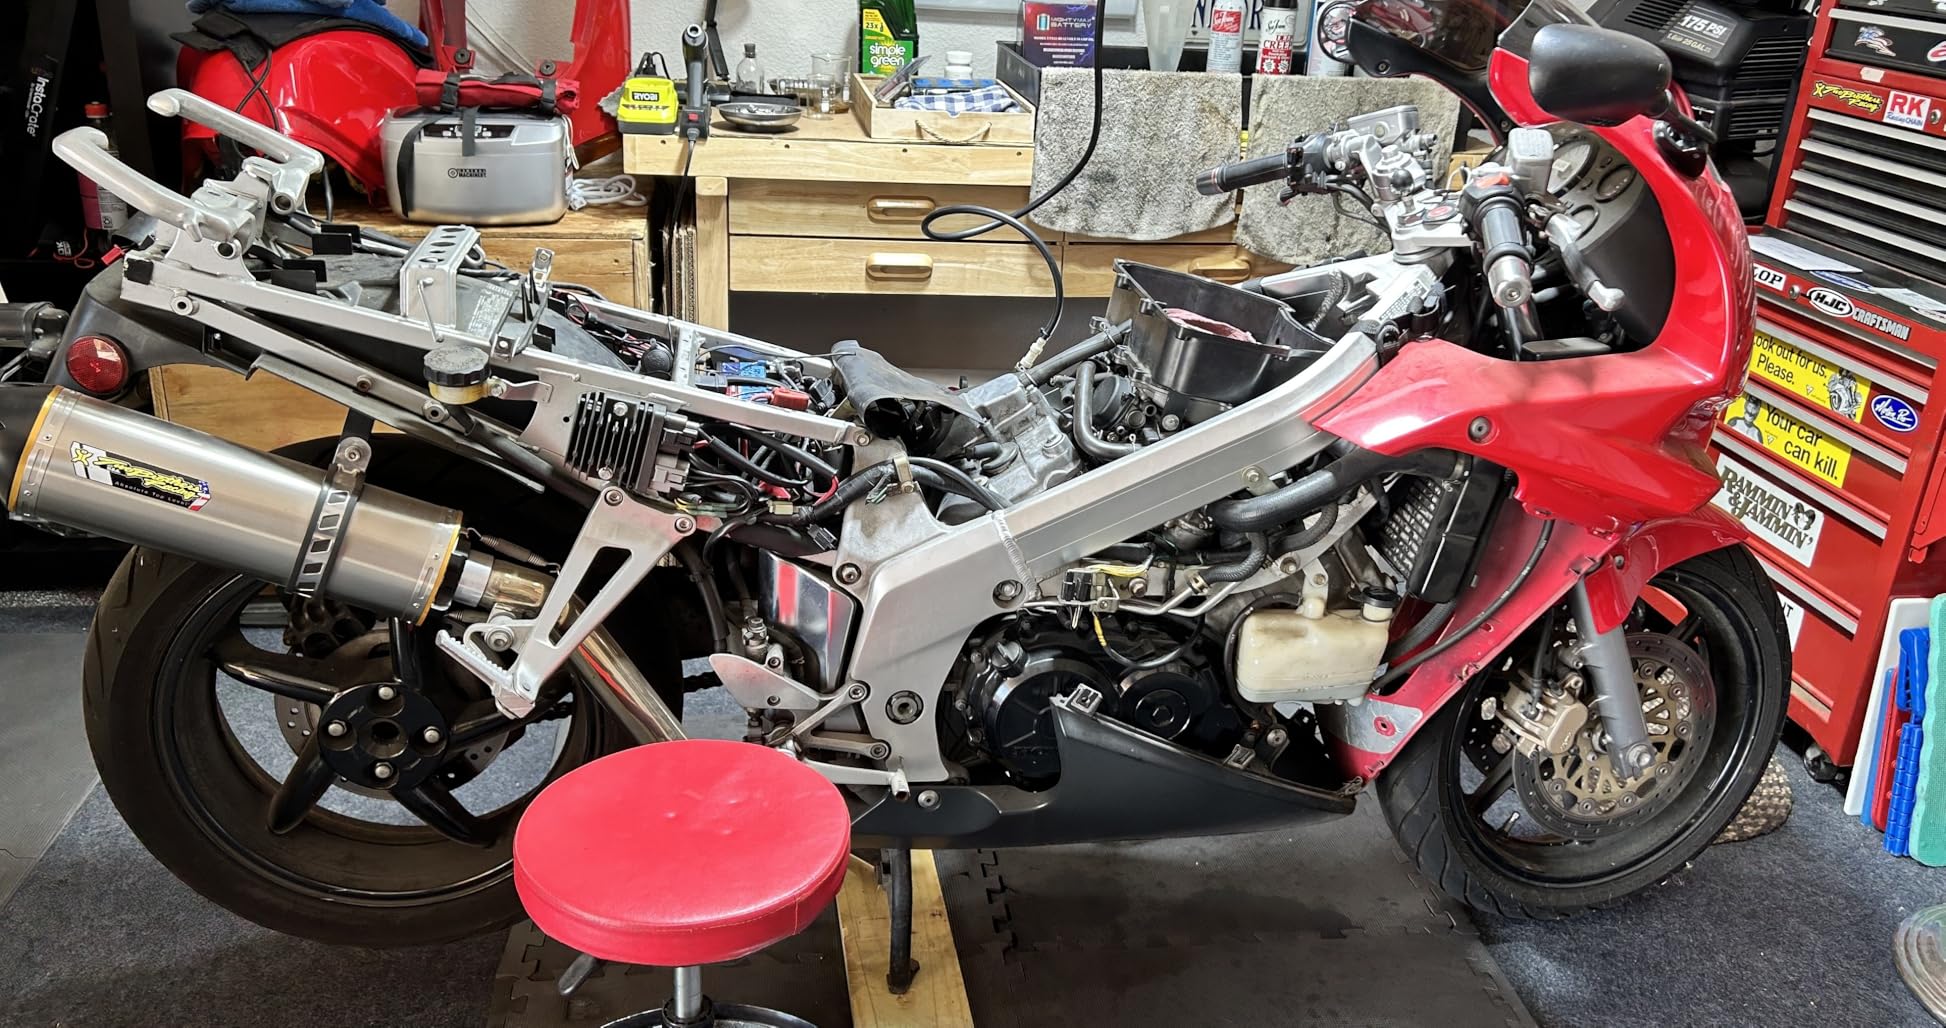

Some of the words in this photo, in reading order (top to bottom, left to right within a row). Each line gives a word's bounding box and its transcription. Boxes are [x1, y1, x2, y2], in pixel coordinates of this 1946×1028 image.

[1678, 14, 1711, 31] 175
[1706, 22, 1728, 36] PSI
[869, 42, 906, 57] simple
[870, 55, 904, 68] green
[27, 76, 50, 137] InstaCrate
[633, 92, 658, 101] RYOBI
[1890, 94, 1925, 117] RK
[1813, 292, 1848, 312] HJC
[1853, 307, 1911, 341] CRAFTSMAN
[1753, 336, 1776, 354] ook
[1776, 344, 1794, 363] out
[1796, 350, 1812, 369] for
[1812, 361, 1827, 378] us.
[1757, 353, 1795, 385] Please.
[1766, 402, 1797, 434] Your
[1797, 426, 1823, 447] car
[1784, 440, 1811, 465] can
[1814, 451, 1838, 481] kill.
[114, 481, 149, 495] Absolute
[152, 491, 165, 500] Top
[1721, 465, 1794, 521] RAMMIN
[1728, 491, 1742, 507] &
